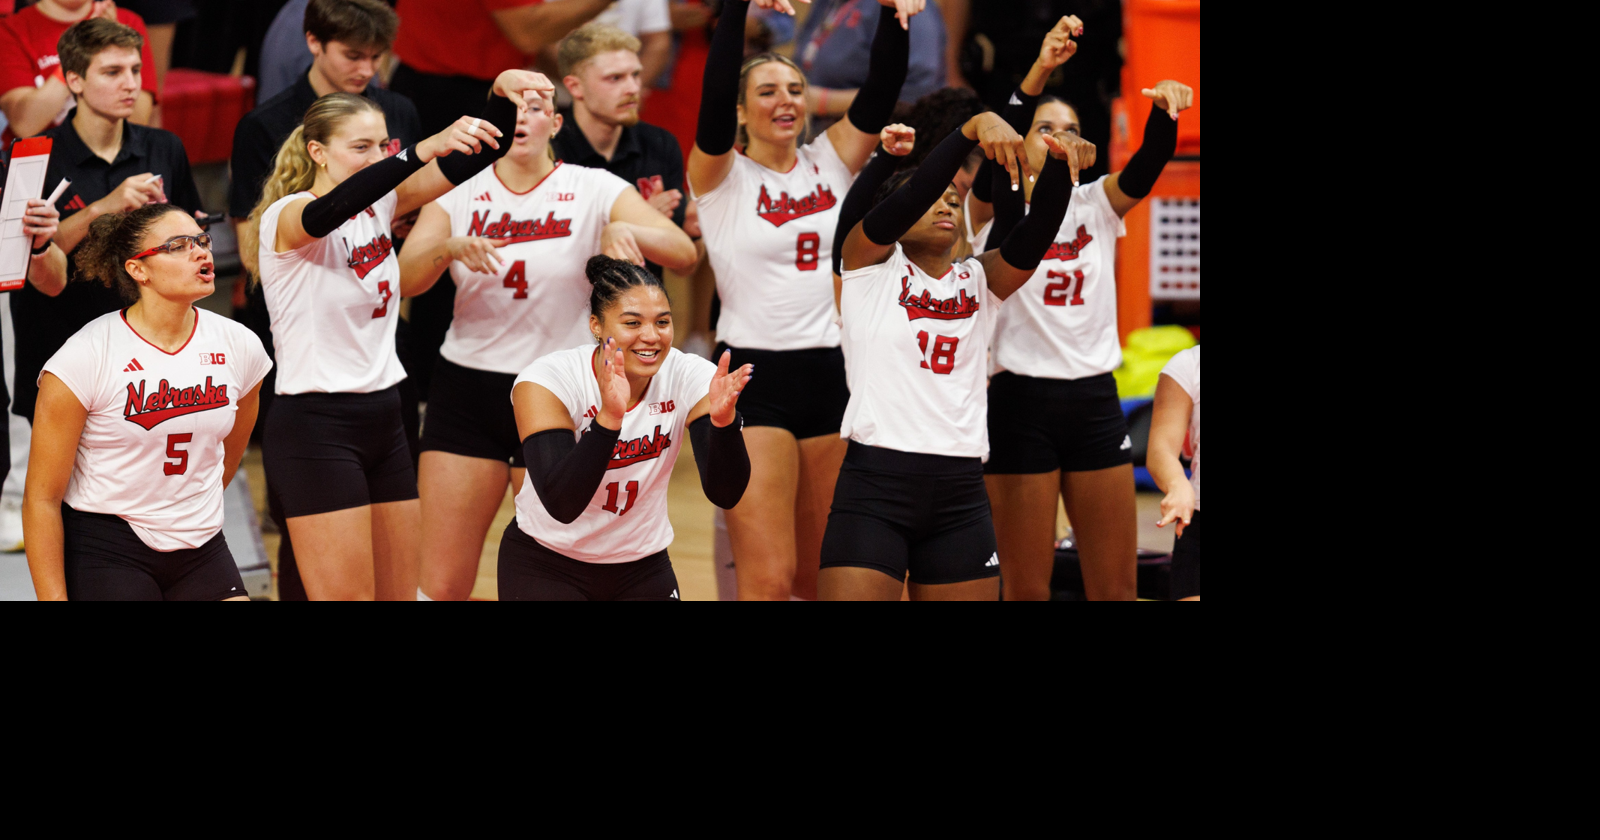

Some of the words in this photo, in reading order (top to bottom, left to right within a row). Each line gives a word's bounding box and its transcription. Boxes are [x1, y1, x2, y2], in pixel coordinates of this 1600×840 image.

[467, 209, 572, 238] Nebraska
[796, 232, 820, 271] 8
[503, 260, 529, 299] 4
[1044, 269, 1084, 306] 21
[372, 280, 392, 319] 3
[917, 330, 959, 375] 18
[124, 376, 229, 418] Nebraska
[163, 432, 193, 476] 5
[611, 425, 671, 459] raska
[602, 481, 639, 516] 11
